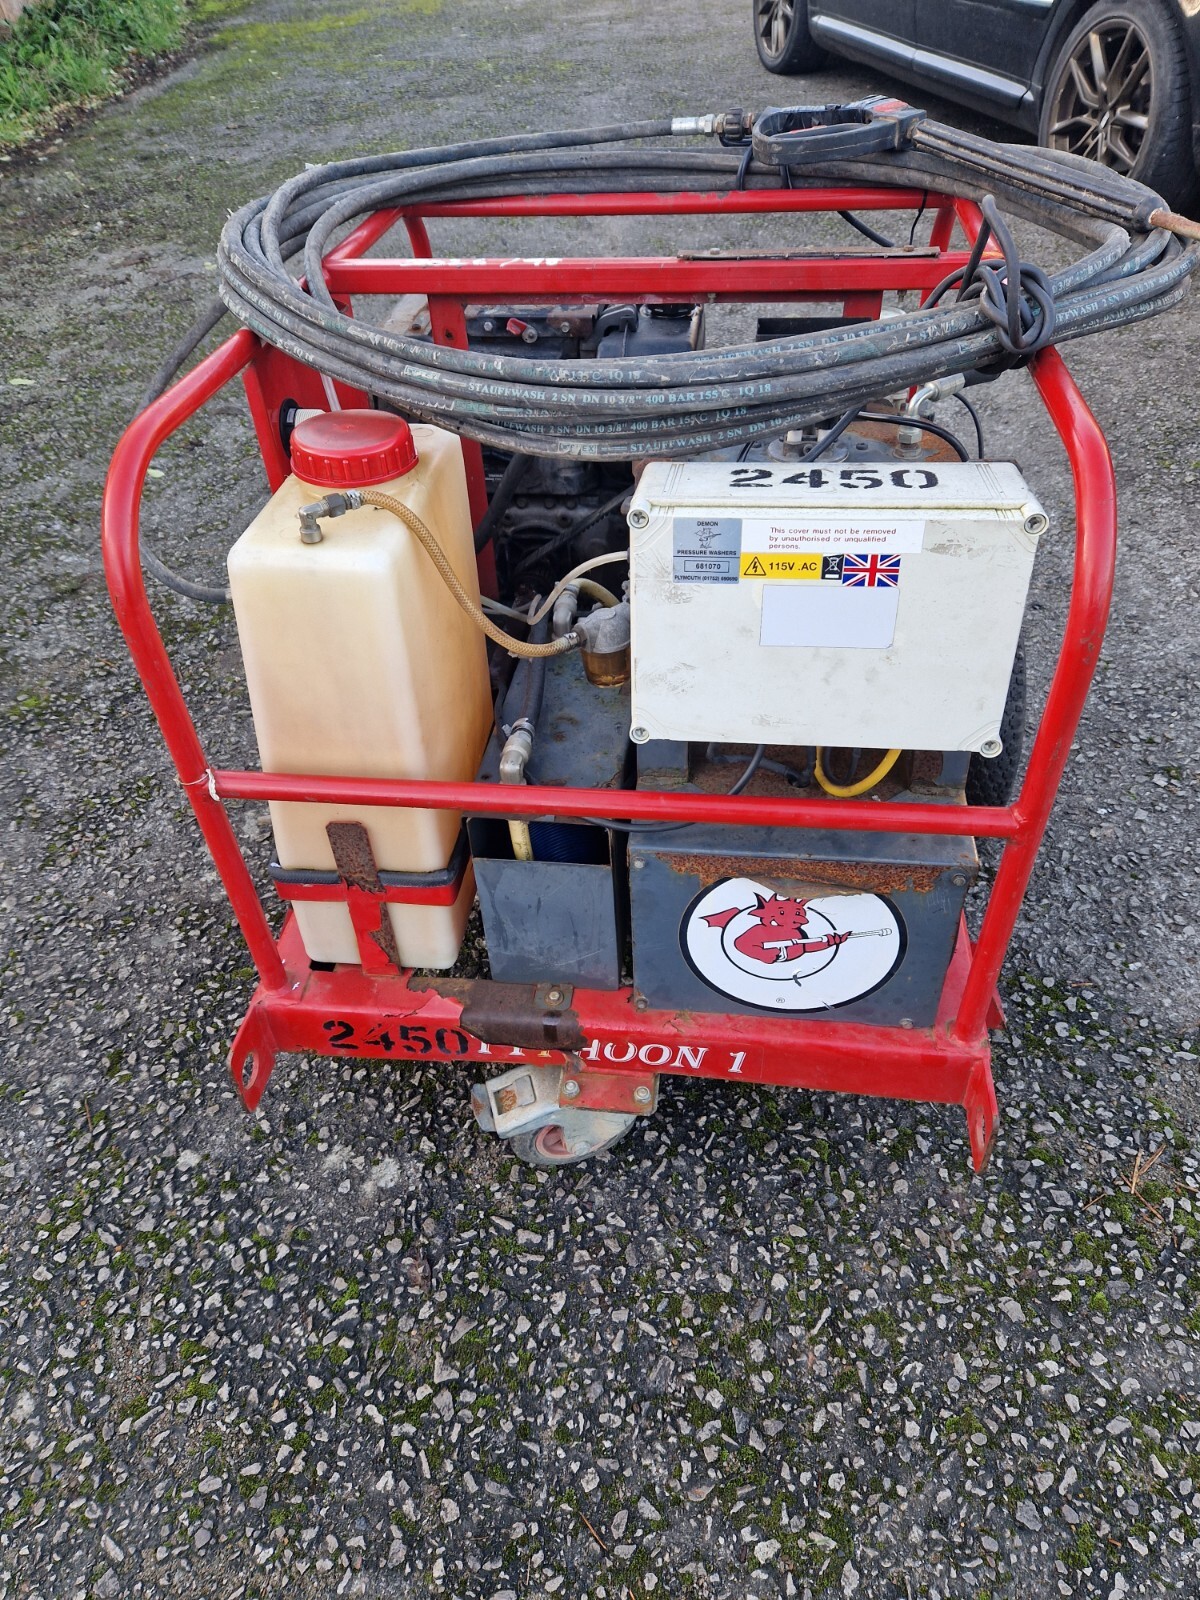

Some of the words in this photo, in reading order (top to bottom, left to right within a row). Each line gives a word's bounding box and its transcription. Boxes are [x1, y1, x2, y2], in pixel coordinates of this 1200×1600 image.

[1108, 294, 1119, 305] SN
[1123, 287, 1135, 300] DN
[798, 340, 814, 349] SN
[468, 382, 546, 400] STAUFFWASH
[551, 393, 558, 401] 2
[560, 394, 576, 402] SN
[582, 395, 600, 404] DN
[603, 395, 615, 404] 10
[619, 395, 641, 404] 3/8"
[645, 394, 665, 404] 400
[668, 392, 695, 403] BAR
[739, 386, 755, 397] 1Q
[758, 384, 771, 394] 18
[549, 425, 555, 433] 2
[557, 425, 570, 433] SN
[576, 425, 590, 434] DN
[594, 424, 605, 433] 10
[607, 422, 627, 432] 3/8"
[630, 421, 648, 431] 400
[651, 418, 676, 430] BAR
[716, 409, 731, 421] 1Q
[735, 406, 747, 416] 18
[630, 434, 711, 452] STAUFFWASH
[718, 431, 724, 439] 2
[727, 427, 742, 438] SN
[749, 421, 766, 433] DN
[770, 417, 782, 426] 10
[729, 468, 938, 489] 2450
[769, 562, 796, 571] 115V
[323, 1020, 469, 1056] 2450
[727, 1051, 747, 1074] 1
